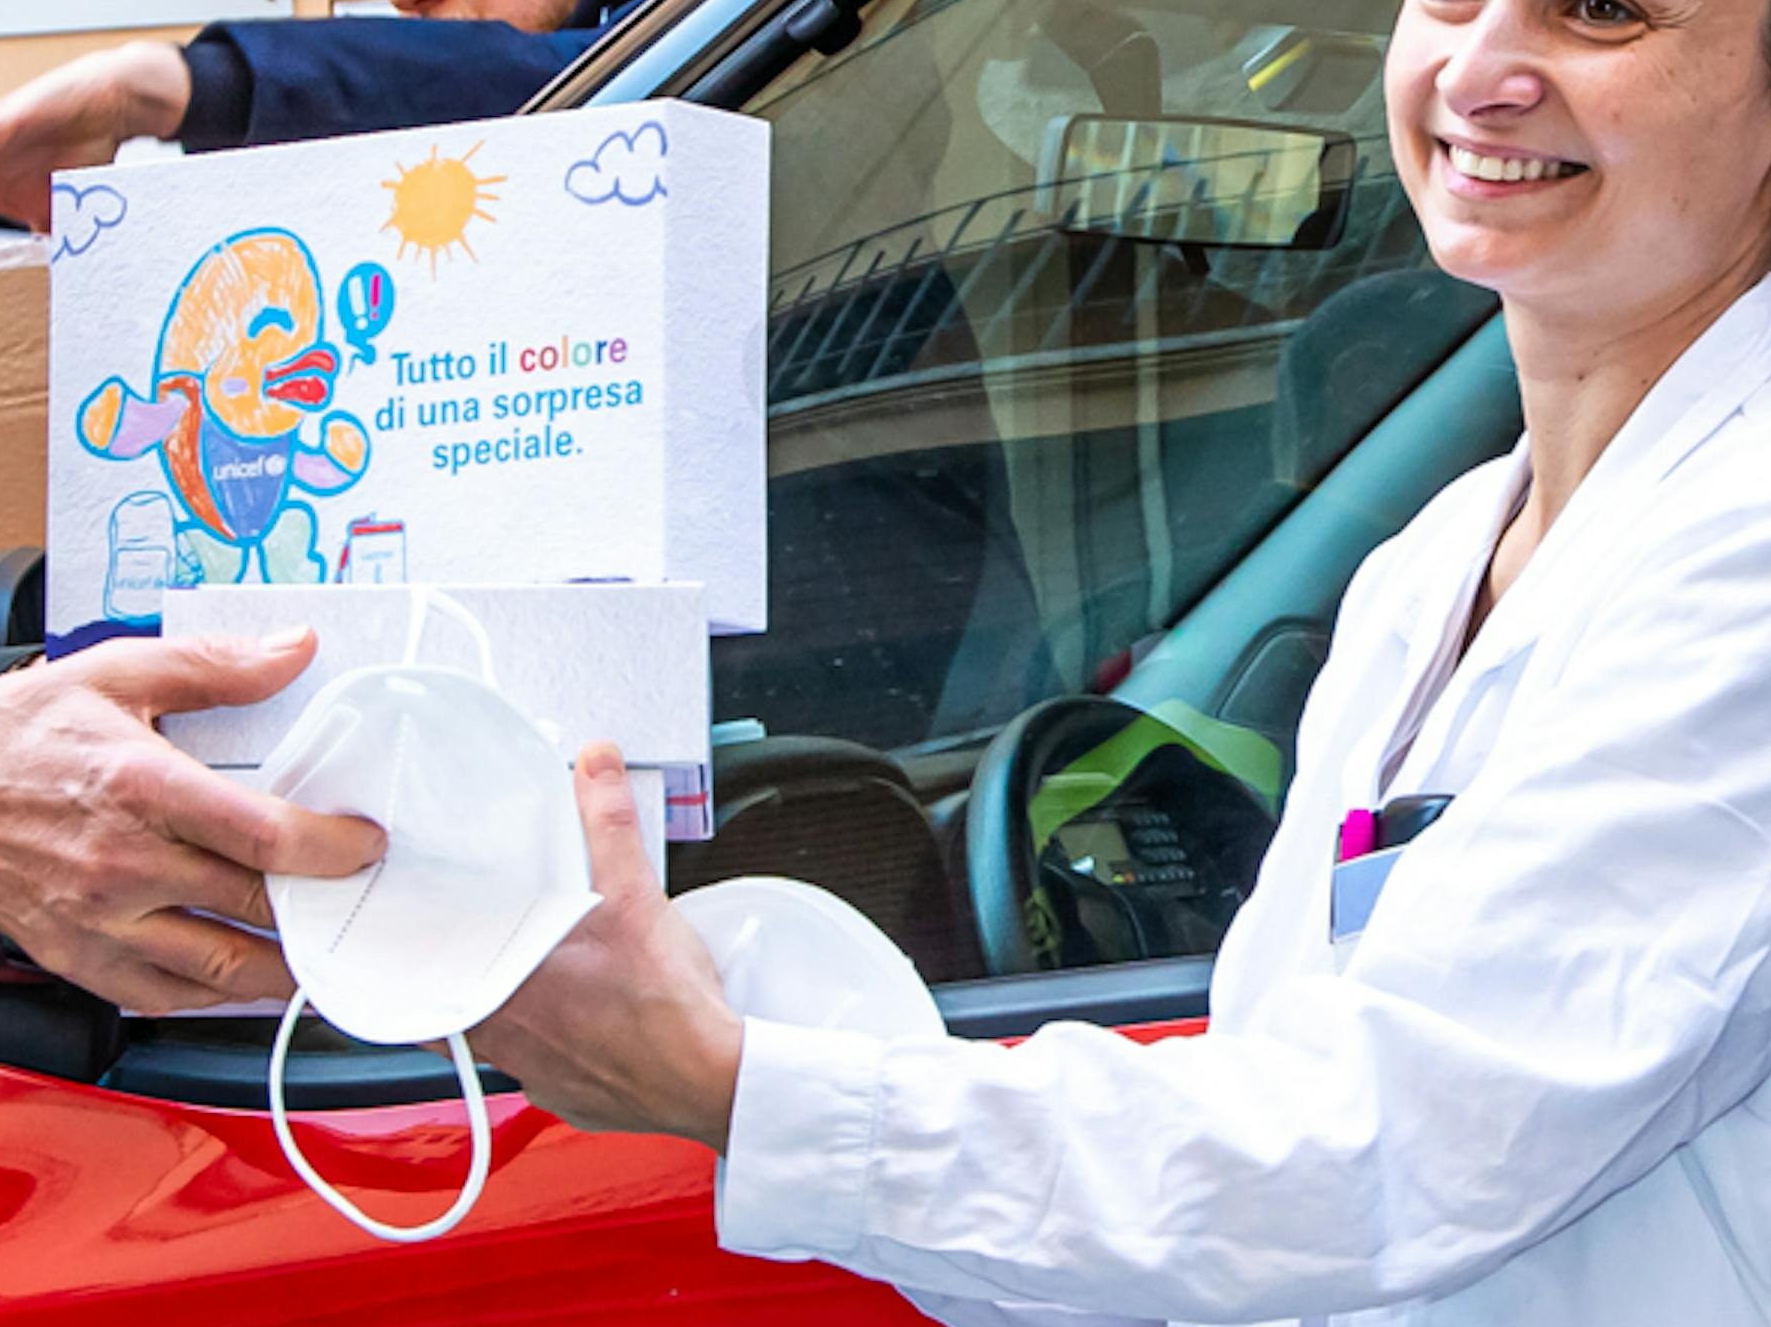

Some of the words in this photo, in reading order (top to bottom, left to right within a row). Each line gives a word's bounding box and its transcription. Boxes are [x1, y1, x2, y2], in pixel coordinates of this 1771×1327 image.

[391, 351, 476, 386] Tutto
[489, 341, 507, 375] il
[520, 335, 628, 373] colore
[375, 396, 405, 431] di
[418, 397, 480, 427] una
[493, 379, 644, 422] sorpresa
[213, 456, 264, 481] unicef
[432, 425, 583, 476] speciale.
